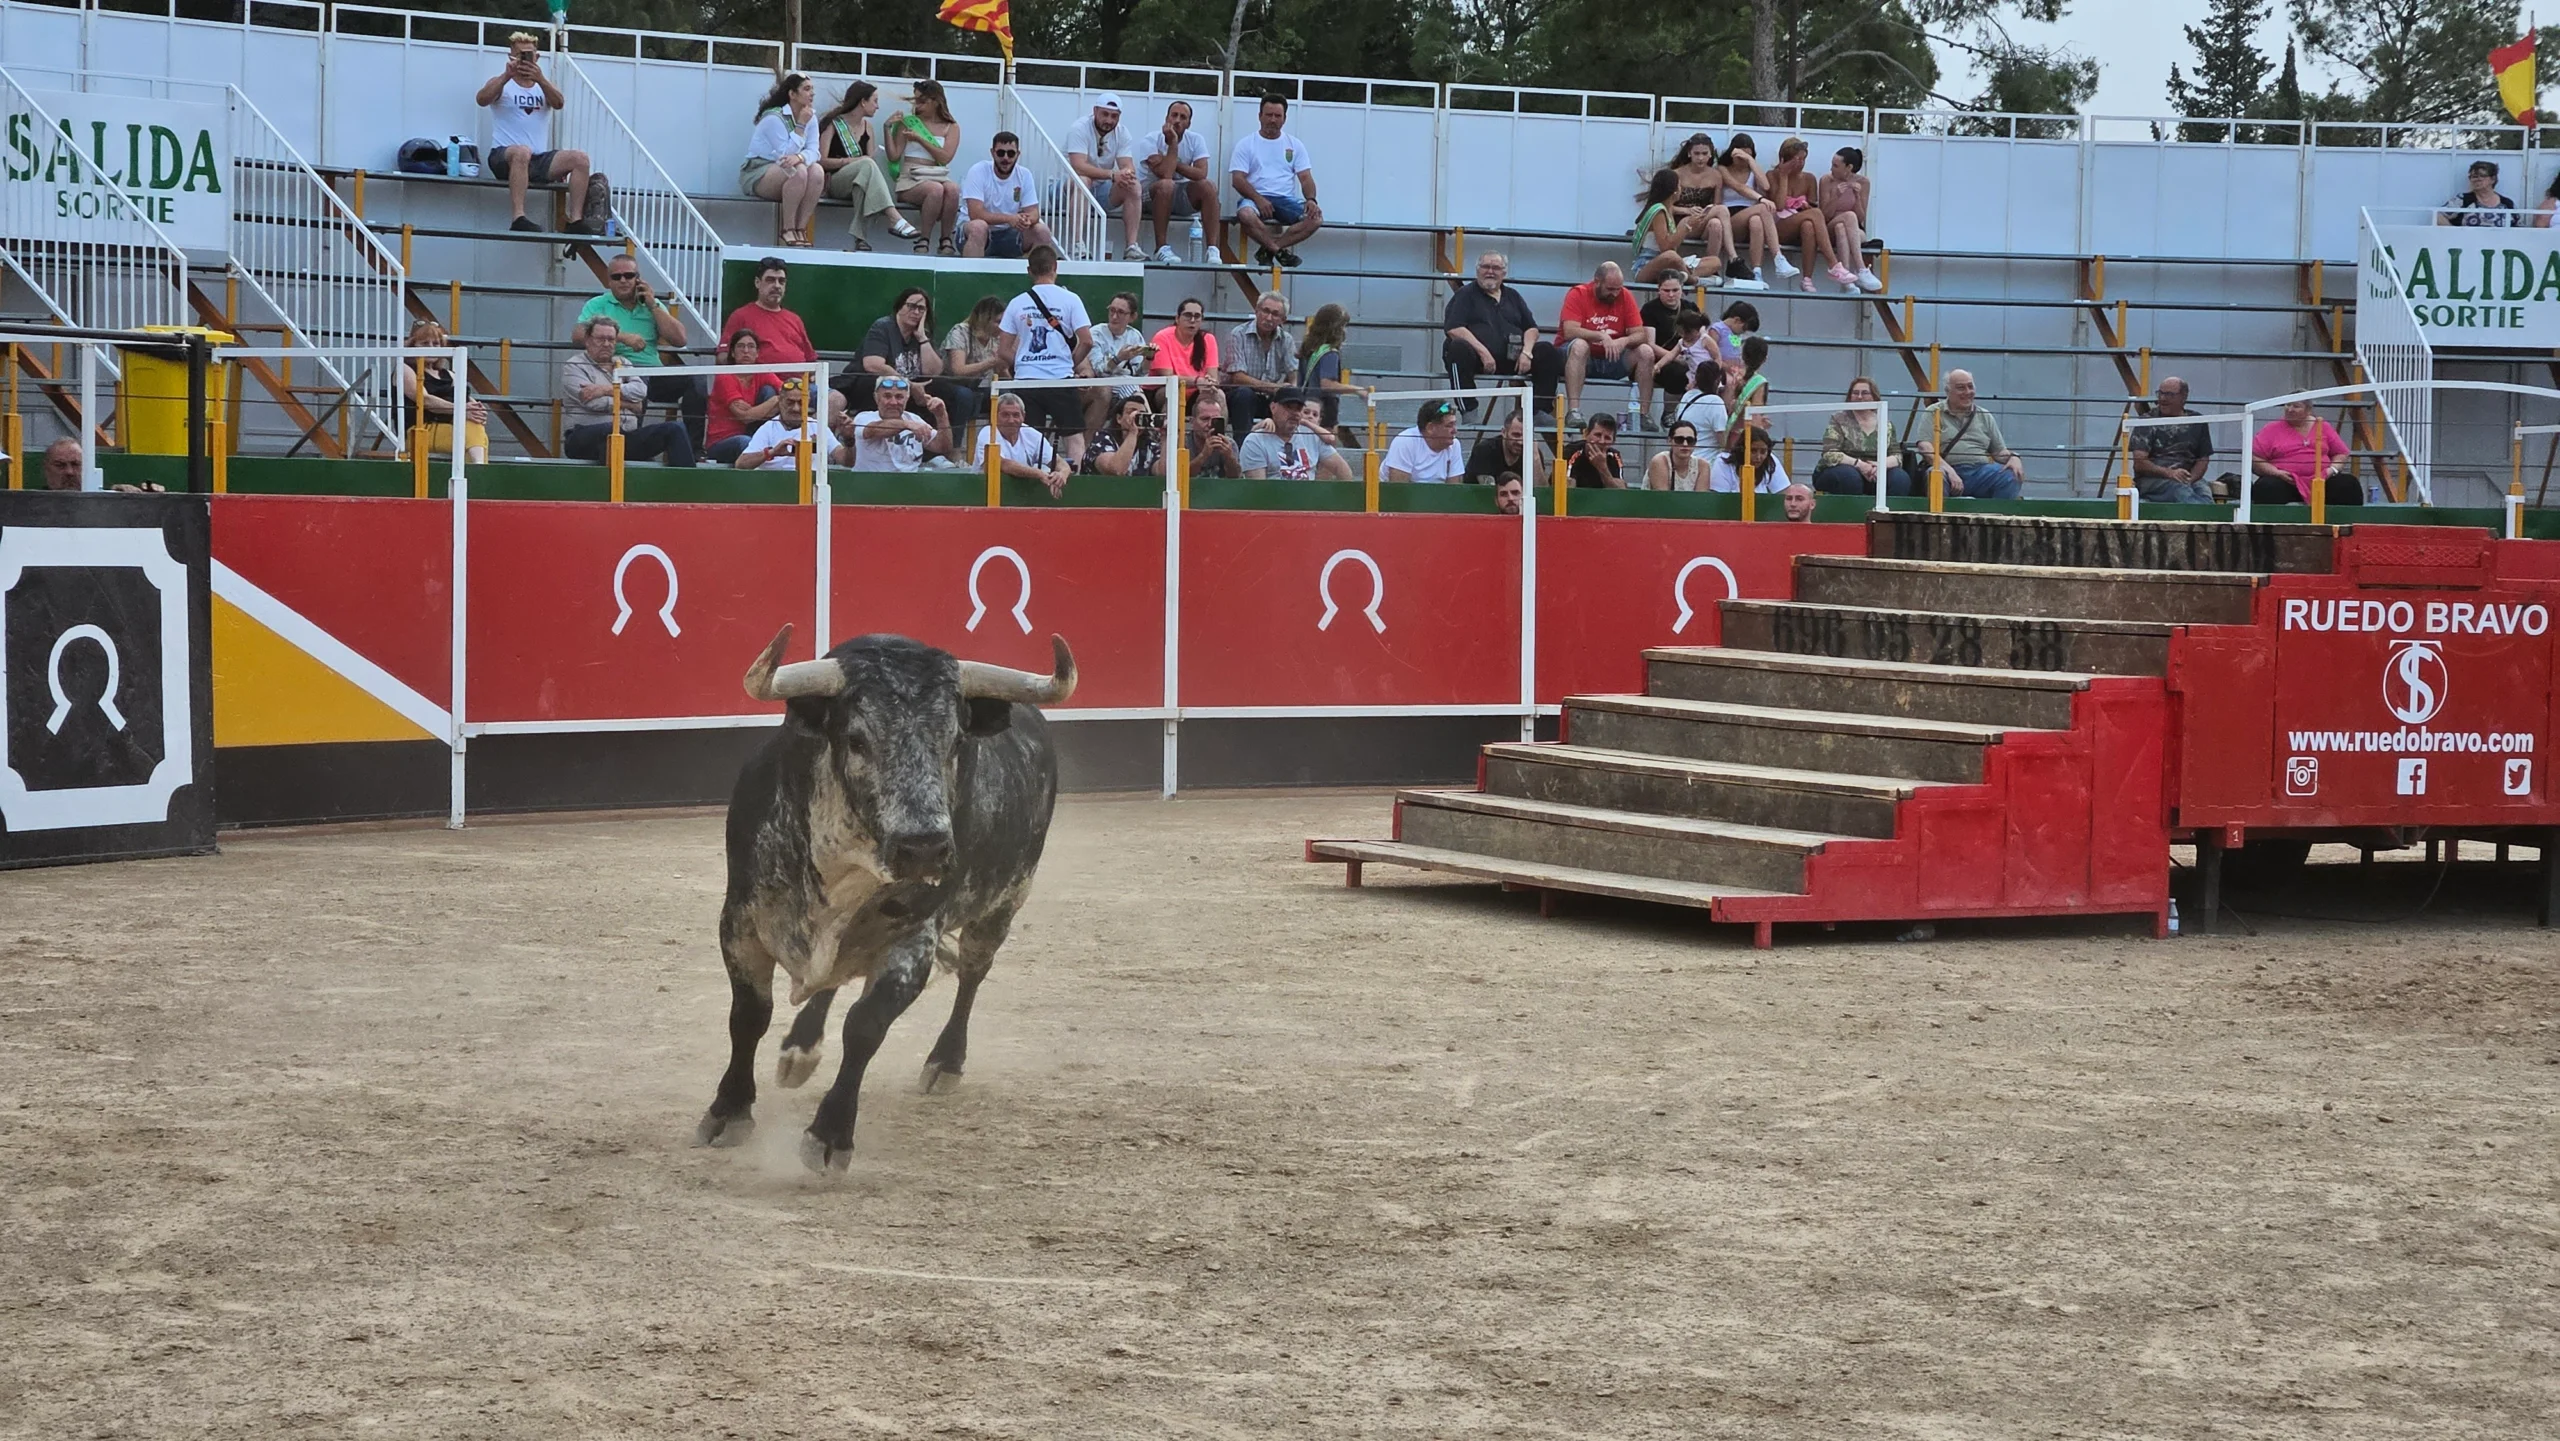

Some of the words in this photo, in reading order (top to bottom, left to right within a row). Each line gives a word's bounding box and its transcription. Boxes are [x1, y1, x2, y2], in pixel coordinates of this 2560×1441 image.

[514, 95, 544, 106] ICON
[3, 112, 221, 193] SALIDA
[2414, 304, 2526, 328] SORTIE
[2284, 599, 2415, 633] RUEDO
[2425, 602, 2549, 636] BRAVO
[2288, 725, 2535, 753] www.ruedobravo.com
